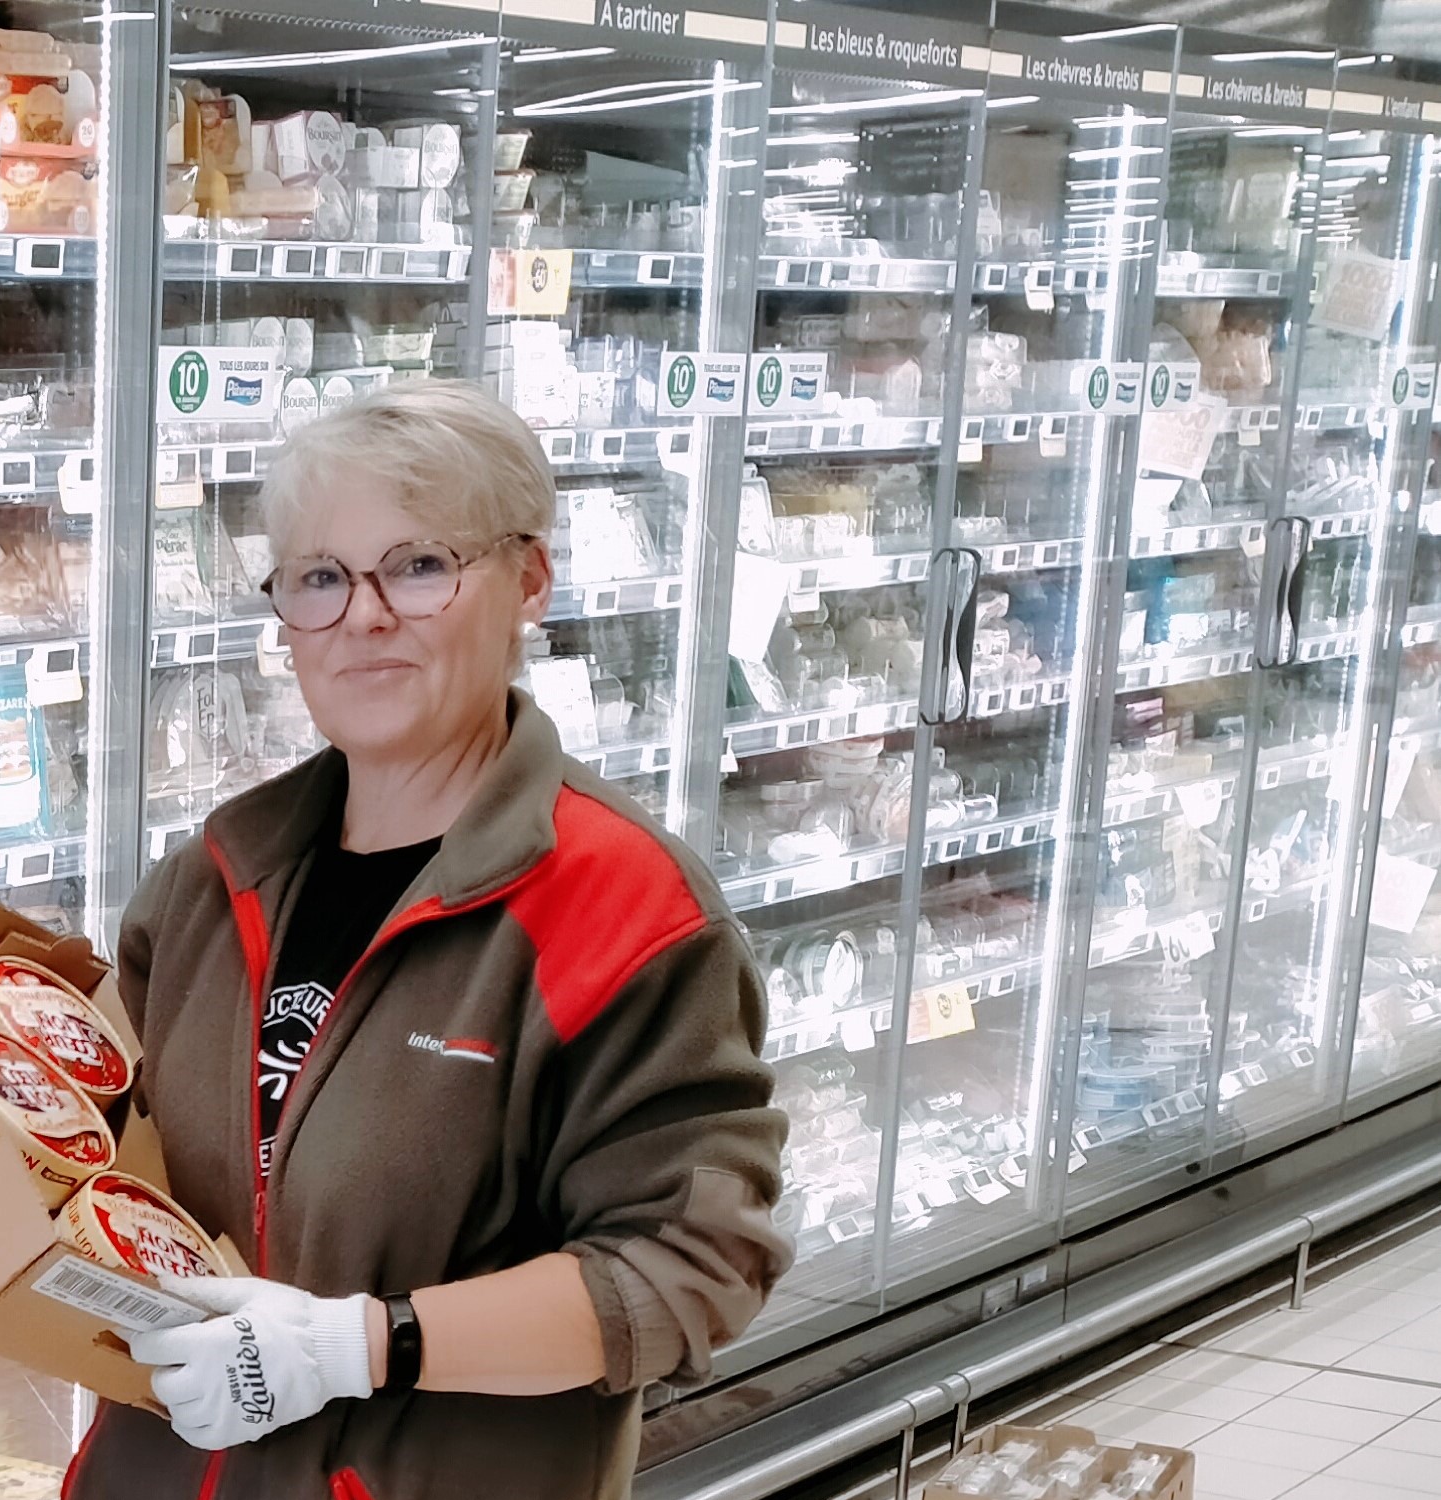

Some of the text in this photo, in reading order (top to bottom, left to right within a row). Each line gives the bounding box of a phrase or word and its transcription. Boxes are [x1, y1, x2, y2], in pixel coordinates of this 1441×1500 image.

[616, 3, 679, 35] tartiner
[811, 24, 957, 69] Les bleus & roqueforts
[1026, 57, 1140, 92] Les chèvres & brebis
[1207, 78, 1303, 108] Les chèvres & brebis
[219, 360, 233, 371] TOUS
[244, 360, 260, 372] JOURS
[260, 361, 270, 371] SUR
[283, 394, 317, 412] Boursin
[408, 1031, 445, 1056] Inter
[233, 1316, 275, 1424] Laitière
